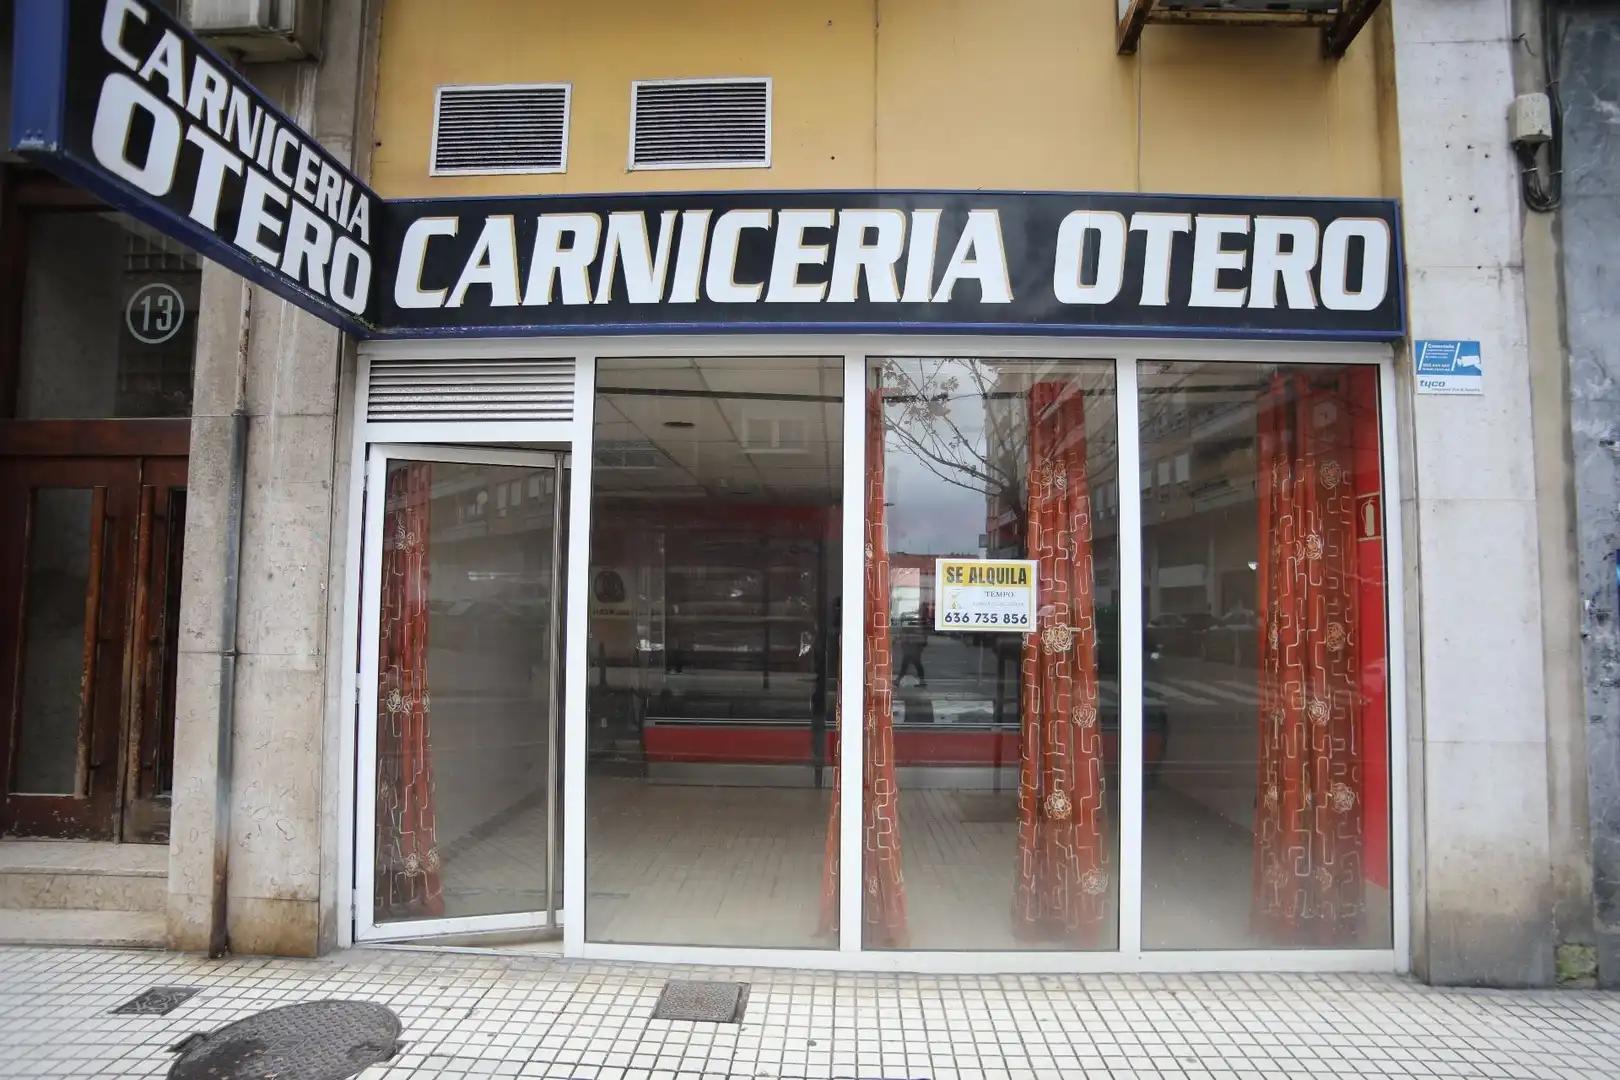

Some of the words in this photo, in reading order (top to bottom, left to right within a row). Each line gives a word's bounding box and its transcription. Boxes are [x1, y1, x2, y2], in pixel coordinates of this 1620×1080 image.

[101, 0, 371, 245] CARNICERIA
[92, 72, 372, 315] OTERO
[394, 209, 1014, 308] CARNICERIA
[1053, 210, 1391, 311] OTERO
[139, 294, 173, 332] 13
[1419, 379, 1446, 388] tyco
[946, 566, 963, 584] SE
[968, 566, 1027, 585] ALQUILA
[944, 612, 970, 624] 636
[974, 612, 998, 624] 735
[1003, 613, 1028, 625] 856
